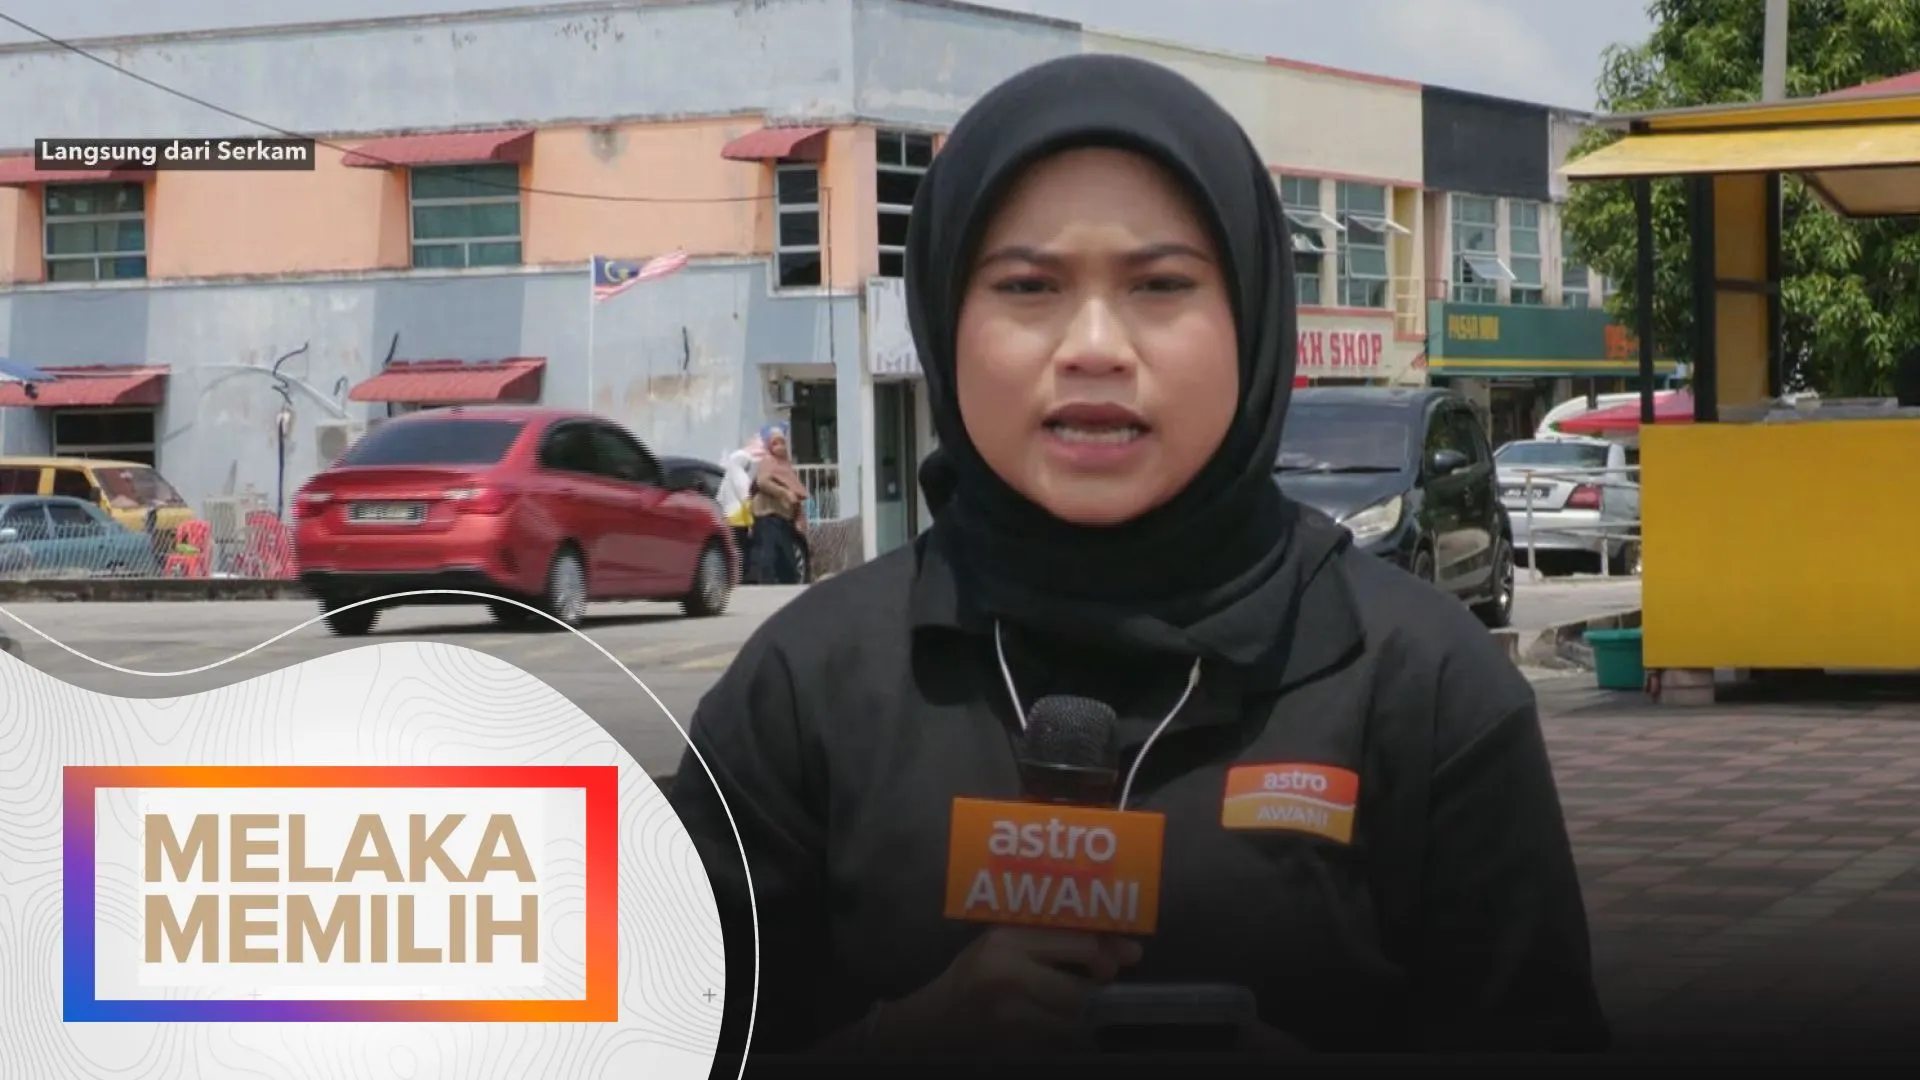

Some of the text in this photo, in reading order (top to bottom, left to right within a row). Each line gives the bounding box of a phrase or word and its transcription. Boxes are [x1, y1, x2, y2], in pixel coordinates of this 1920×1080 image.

[1329, 332, 1382, 367] SHOP
[1263, 769, 1328, 793] astro
[1257, 804, 1328, 827] AWANI
[988, 818, 1117, 862] astro
[964, 868, 1140, 923] AWANI
